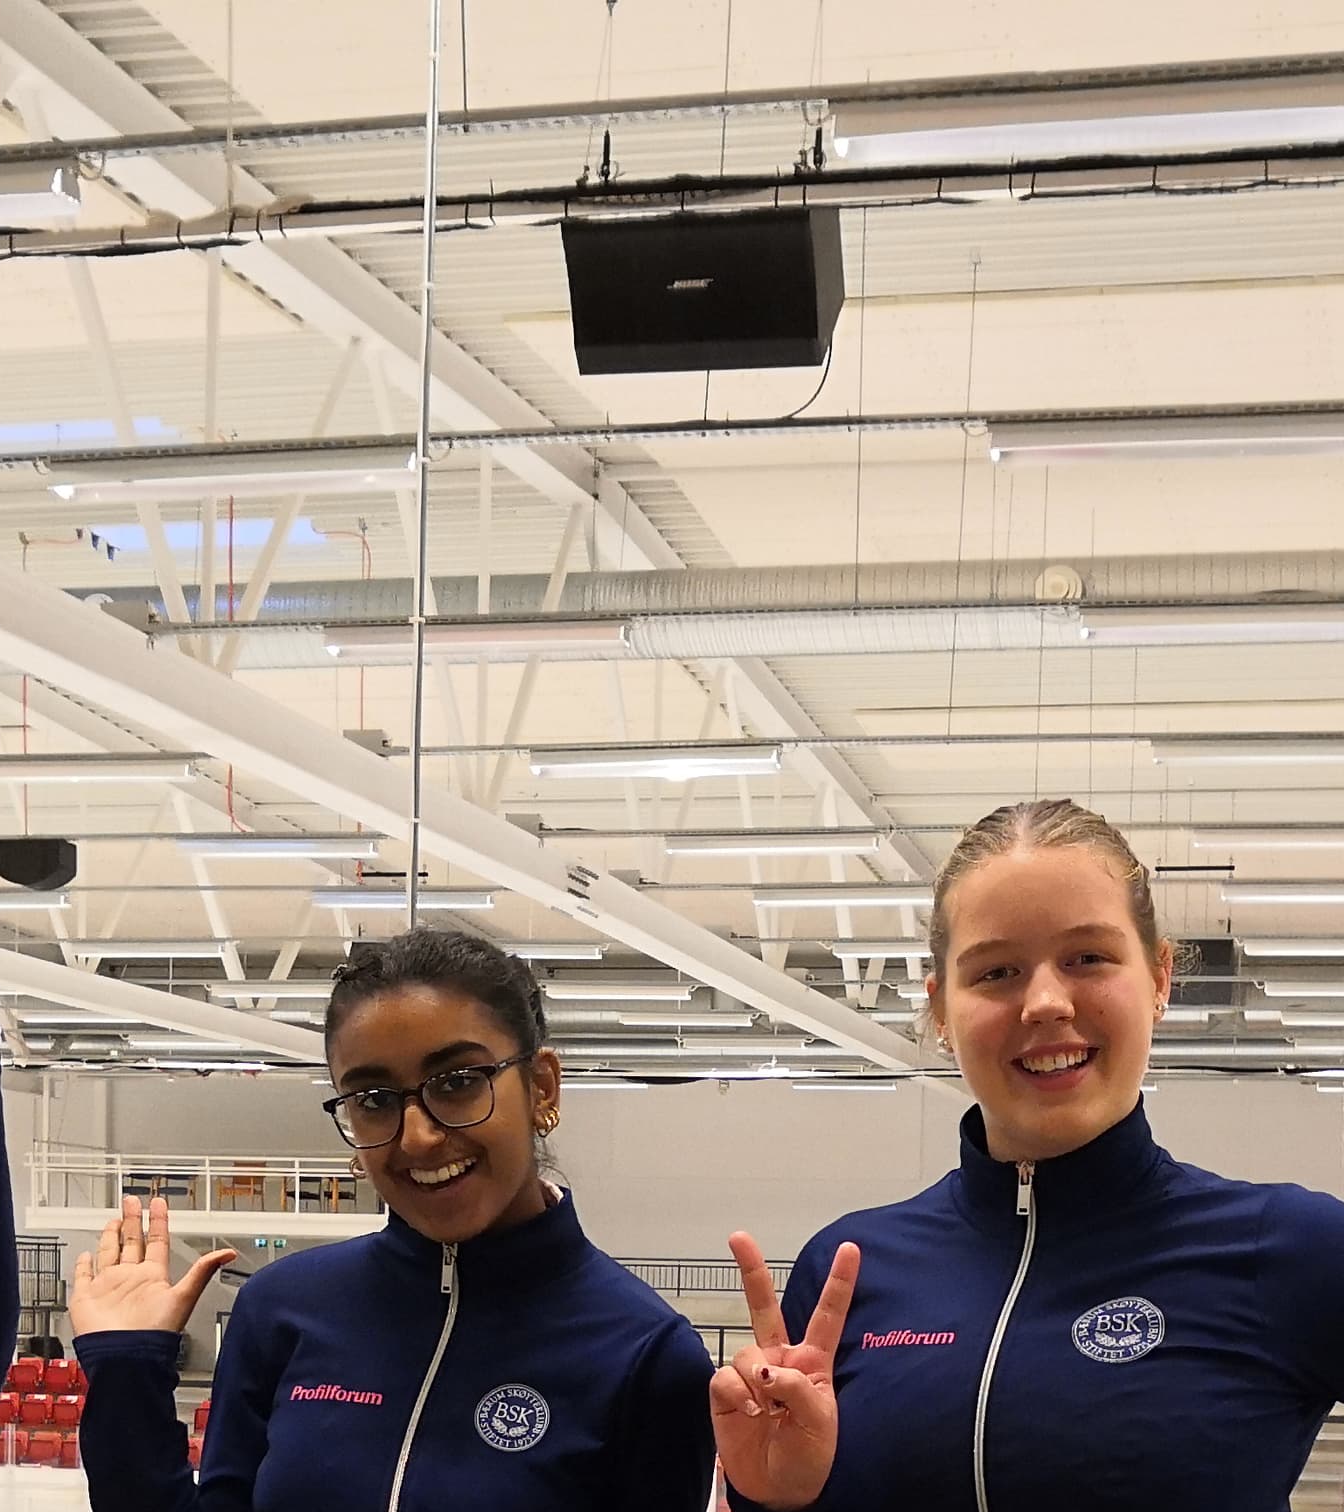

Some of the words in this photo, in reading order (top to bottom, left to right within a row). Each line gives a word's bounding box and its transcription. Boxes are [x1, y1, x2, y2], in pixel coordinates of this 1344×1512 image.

[1095, 1312, 1143, 1333] BSK
[861, 1329, 956, 1350] Profilforum
[289, 1384, 384, 1406] Profilforum
[494, 1401, 534, 1426] BSK
